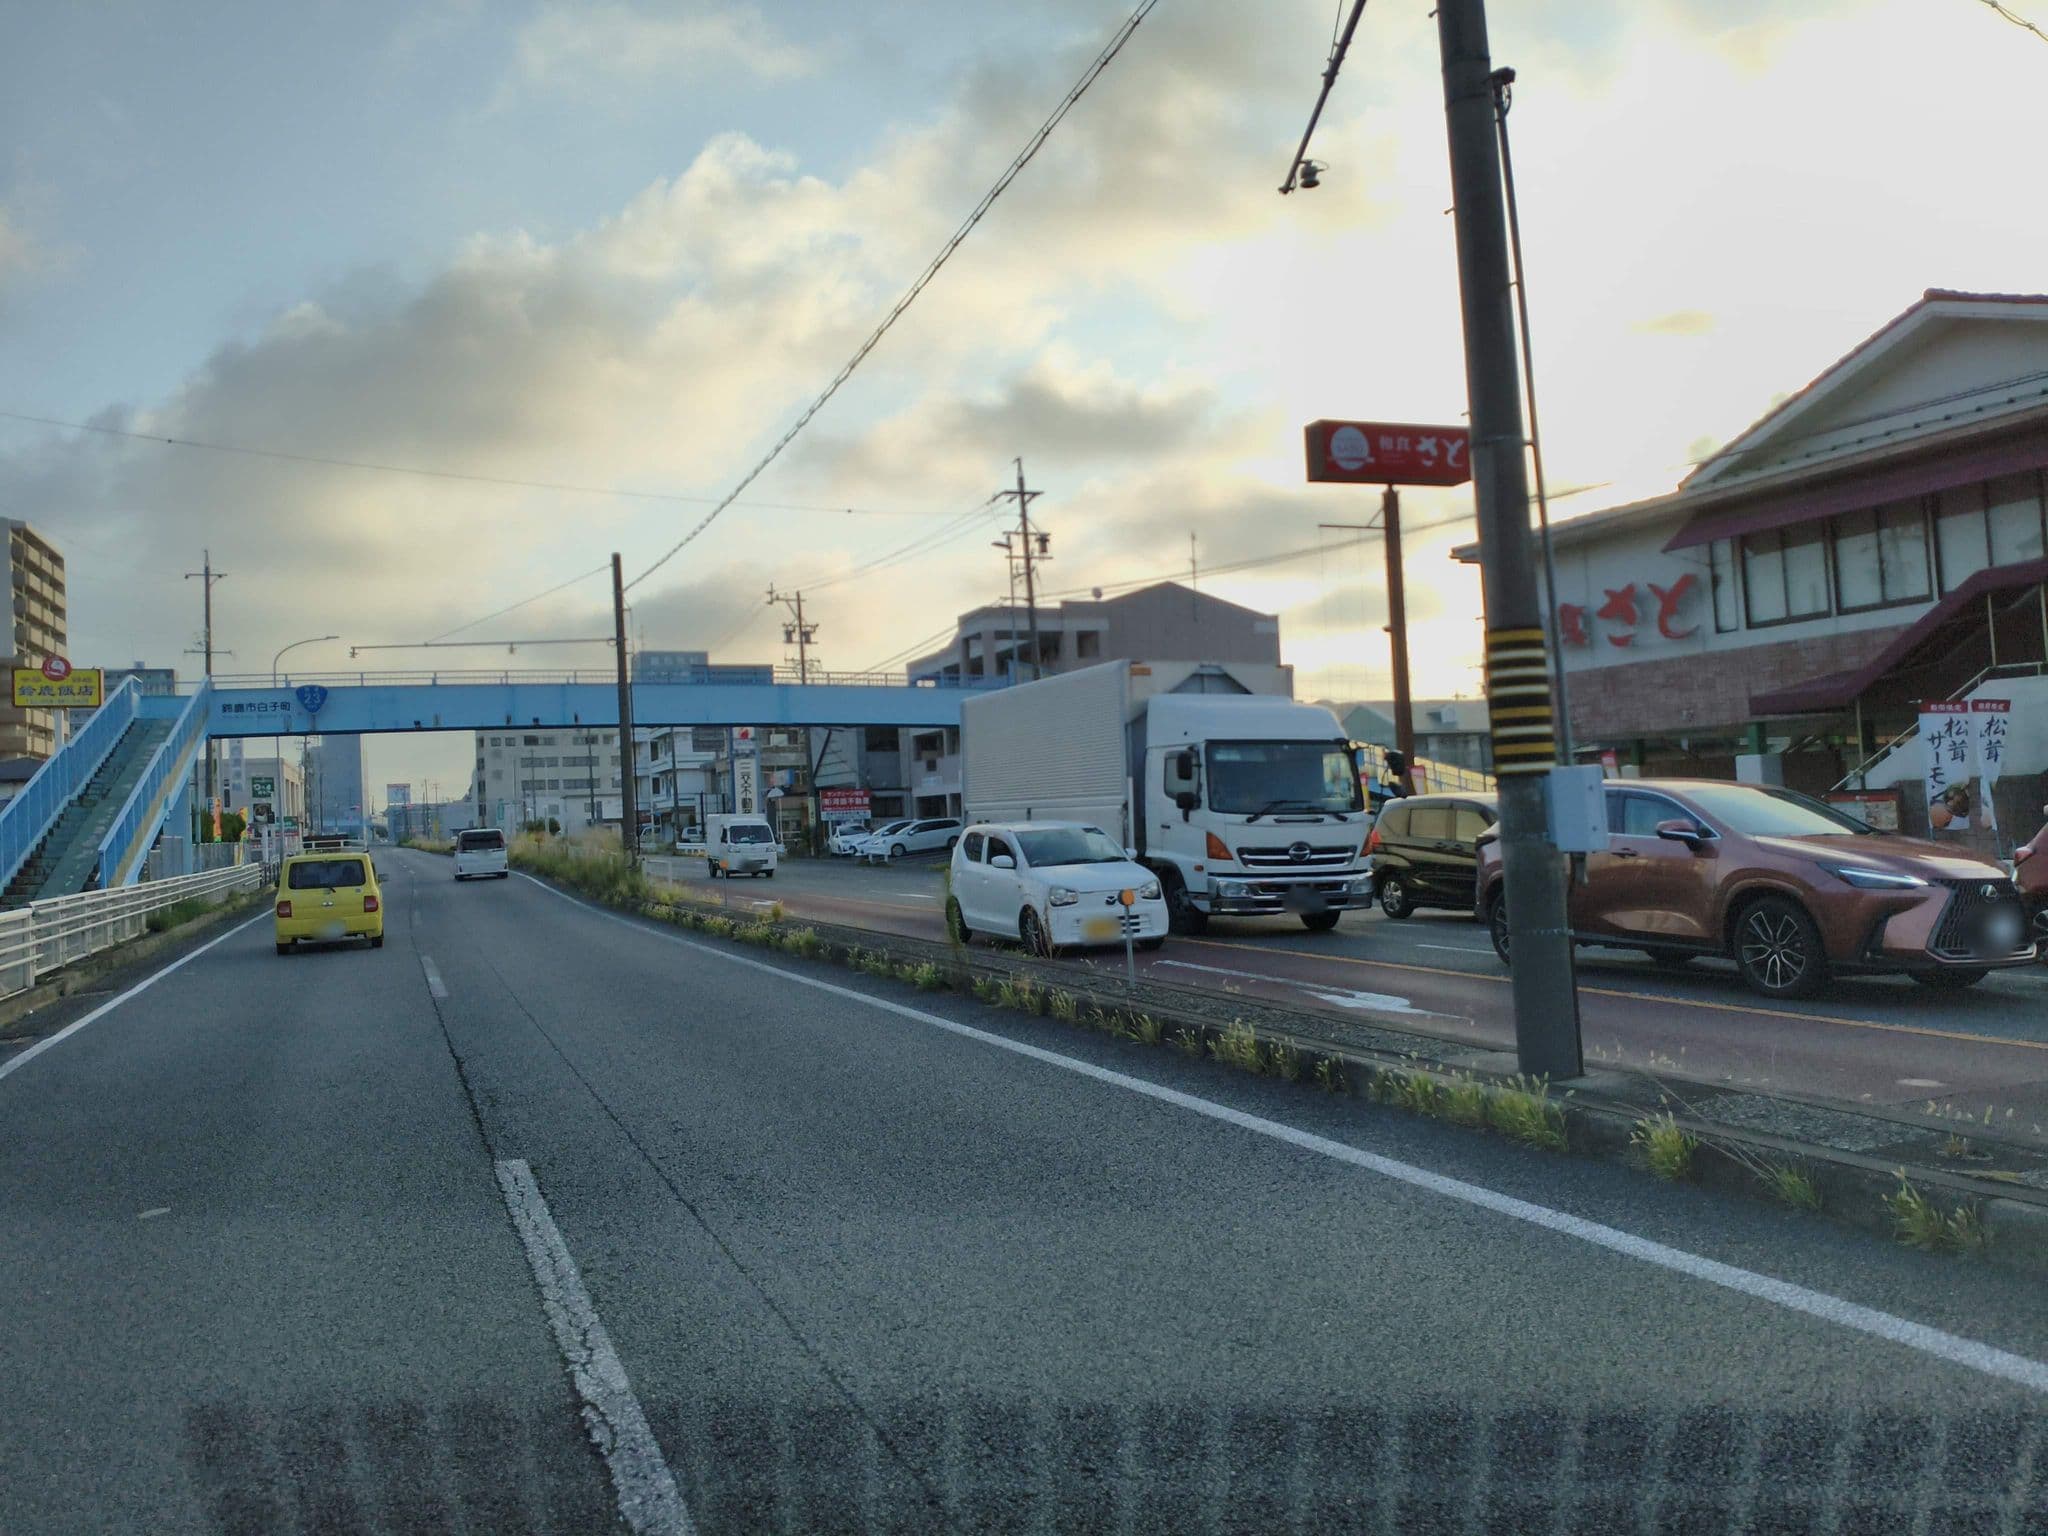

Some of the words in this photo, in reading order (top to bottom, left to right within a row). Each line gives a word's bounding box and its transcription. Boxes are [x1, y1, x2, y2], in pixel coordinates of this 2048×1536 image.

[221, 701, 292, 713] 鈴鹿市白子町
[303, 693, 321, 704] 23
[1944, 715, 1969, 763] 松茸
[1984, 715, 2008, 763] 松茸
[1927, 730, 1947, 806] サーモン
